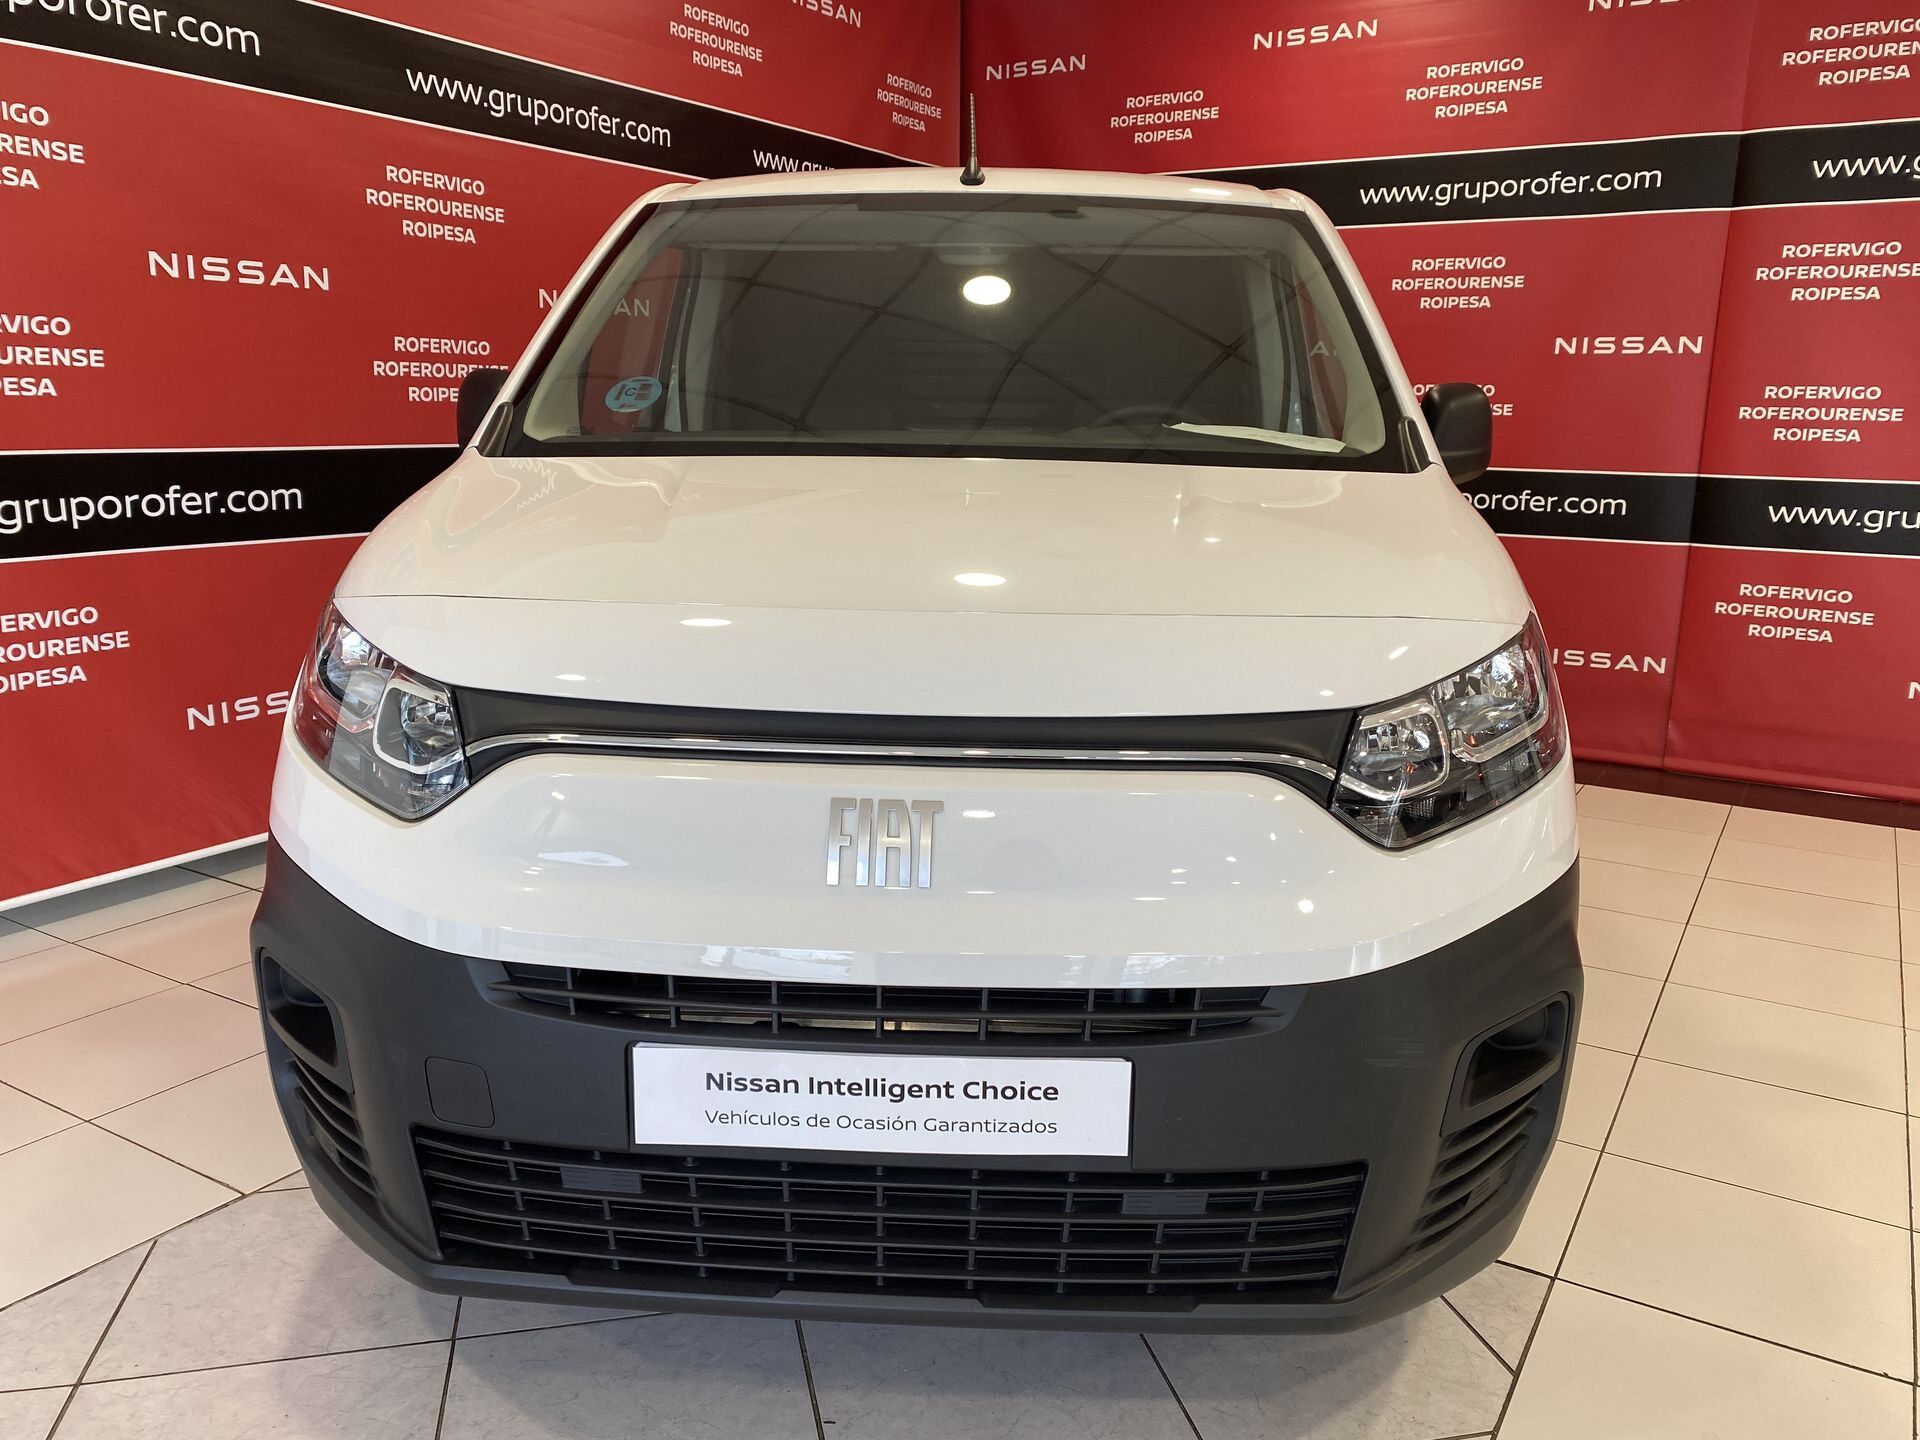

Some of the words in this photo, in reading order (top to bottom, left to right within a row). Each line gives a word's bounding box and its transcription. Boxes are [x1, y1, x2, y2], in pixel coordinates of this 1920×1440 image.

[684, 4, 749, 37] ROFERVIGO
[1810, 19, 1920, 41] ROFERVIG
[670, 19, 762, 61] ROFEROURENSE
[1254, 19, 1377, 49] NISSAN
[693, 51, 742, 76] ROIPESA
[987, 55, 1085, 80] NISSAN
[1427, 58, 1523, 79] ROFERVIGO
[887, 74, 931, 98] ROFERVIGO
[1819, 65, 1910, 85] ROIPESA
[1127, 90, 1203, 108] ROFERVIGO
[1406, 77, 1542, 100] ROFEROURENSE
[406, 68, 671, 148] www.gruporofer.com
[877, 89, 941, 118] ROFEROURENSE
[1436, 101, 1507, 118] ROIPESA
[893, 112, 925, 132] ROIPESA
[1111, 107, 1219, 128] ROFEROURENSE
[1135, 128, 1192, 143] ROIPESA
[0, 166, 39, 189] SA
[386, 165, 484, 195] ROFERVIGO
[1360, 171, 1661, 205] www.gruporofer.com
[366, 189, 504, 223] ROFEROURENSE
[403, 220, 476, 243] ROIPESA
[1782, 242, 1901, 258] ROFERVIGO
[148, 251, 329, 290] NISSAN
[1412, 256, 1505, 271] ROFERVIGO
[1392, 276, 1524, 290] ROFEROURENSE
[1791, 287, 1880, 300] ROIPESA
[1421, 296, 1490, 308] ROIPESA
[0, 314, 70, 335] VIGO
[394, 337, 490, 355] ROFERVIGO
[1555, 336, 1702, 354] NISSAN
[0, 378, 57, 396] ESA
[409, 387, 458, 402] ROIPE
[1765, 386, 1881, 399] ROFERVIGO
[1739, 407, 1904, 421] ROFEROURENSE
[1774, 428, 1860, 442] ROIPESA
[0, 485, 301, 534] gruporofer.com
[1740, 584, 1852, 603] ROFERVIGO
[1715, 602, 1874, 625] ROFEROURENSE
[1749, 624, 1832, 642] ROIPESA
[1553, 649, 1666, 673] ISSAN
[187, 691, 290, 730] NISS
[826, 797, 944, 888] FIAT
[706, 1072, 799, 1094] Nissan
[809, 1077, 955, 1103] Intelligent
[963, 1081, 1059, 1101] Choice
[705, 1110, 800, 1127] Vehículos
[806, 1114, 831, 1128] de
[837, 1115, 917, 1132] Ocasión
[923, 1118, 1058, 1134] Garantizados
